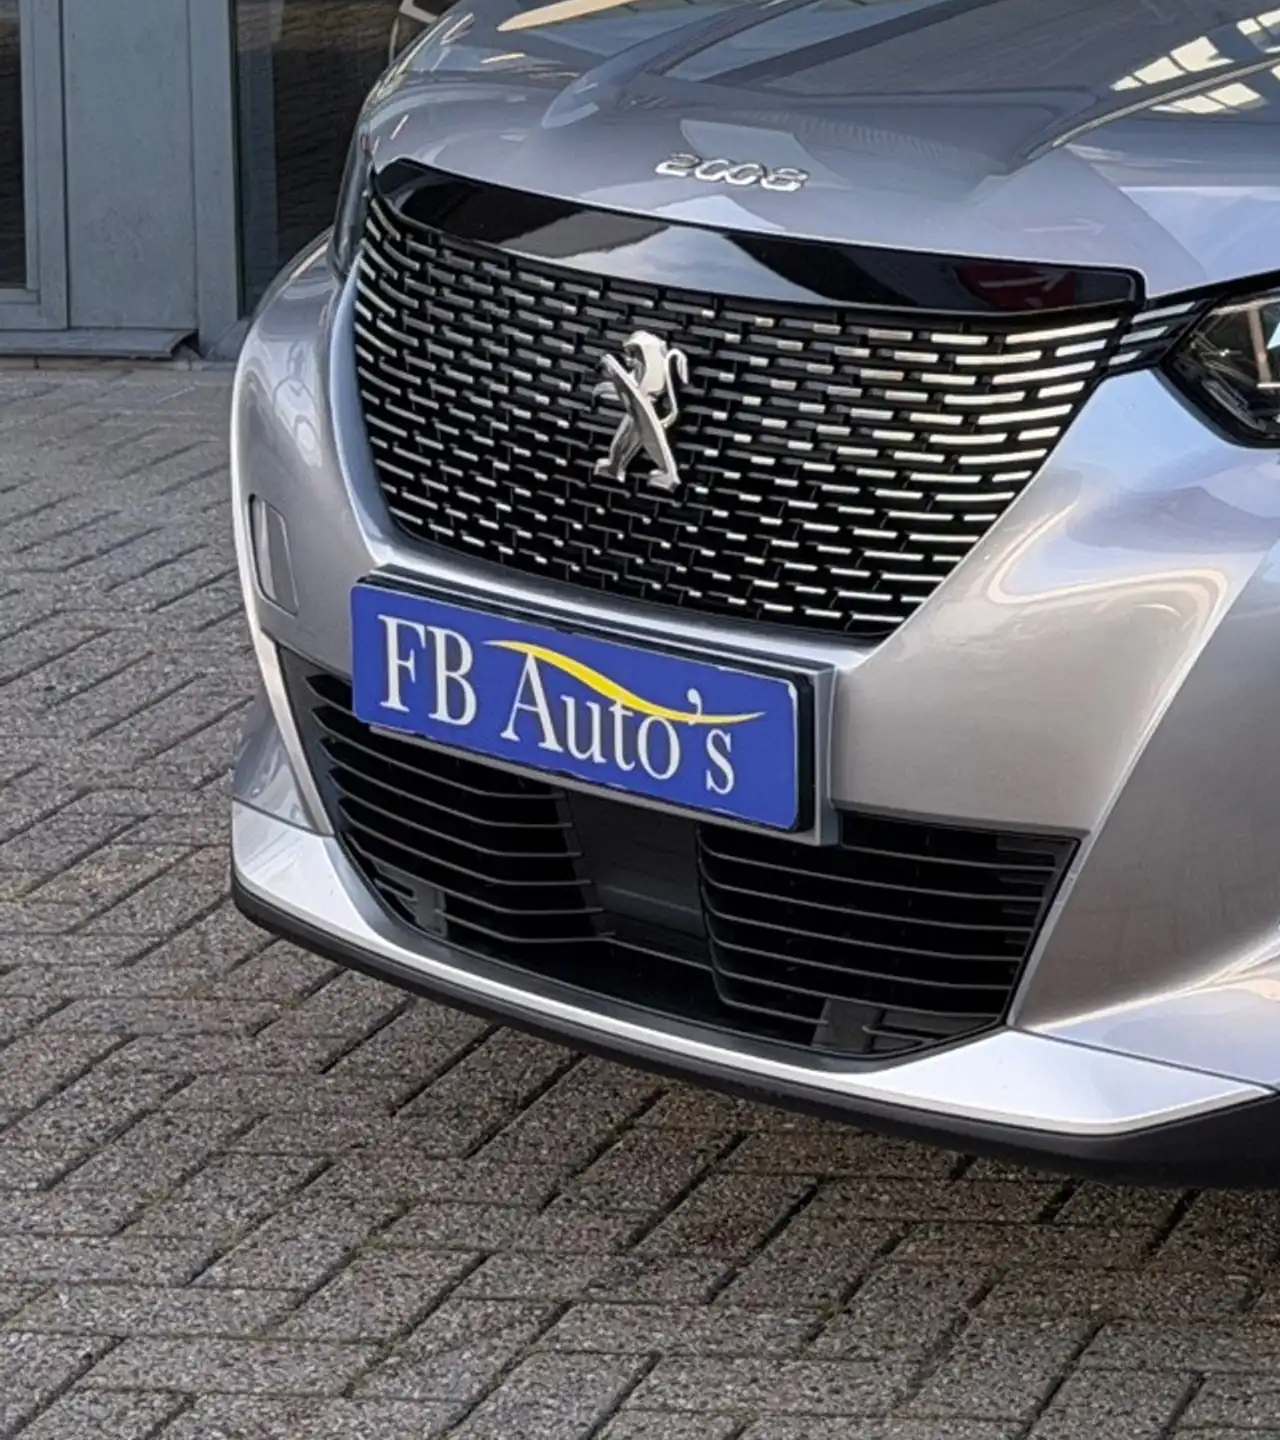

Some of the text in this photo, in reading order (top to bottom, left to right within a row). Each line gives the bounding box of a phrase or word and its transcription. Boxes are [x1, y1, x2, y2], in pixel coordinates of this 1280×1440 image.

[654, 152, 810, 192] 2008
[377, 613, 736, 796] FB Auto's
